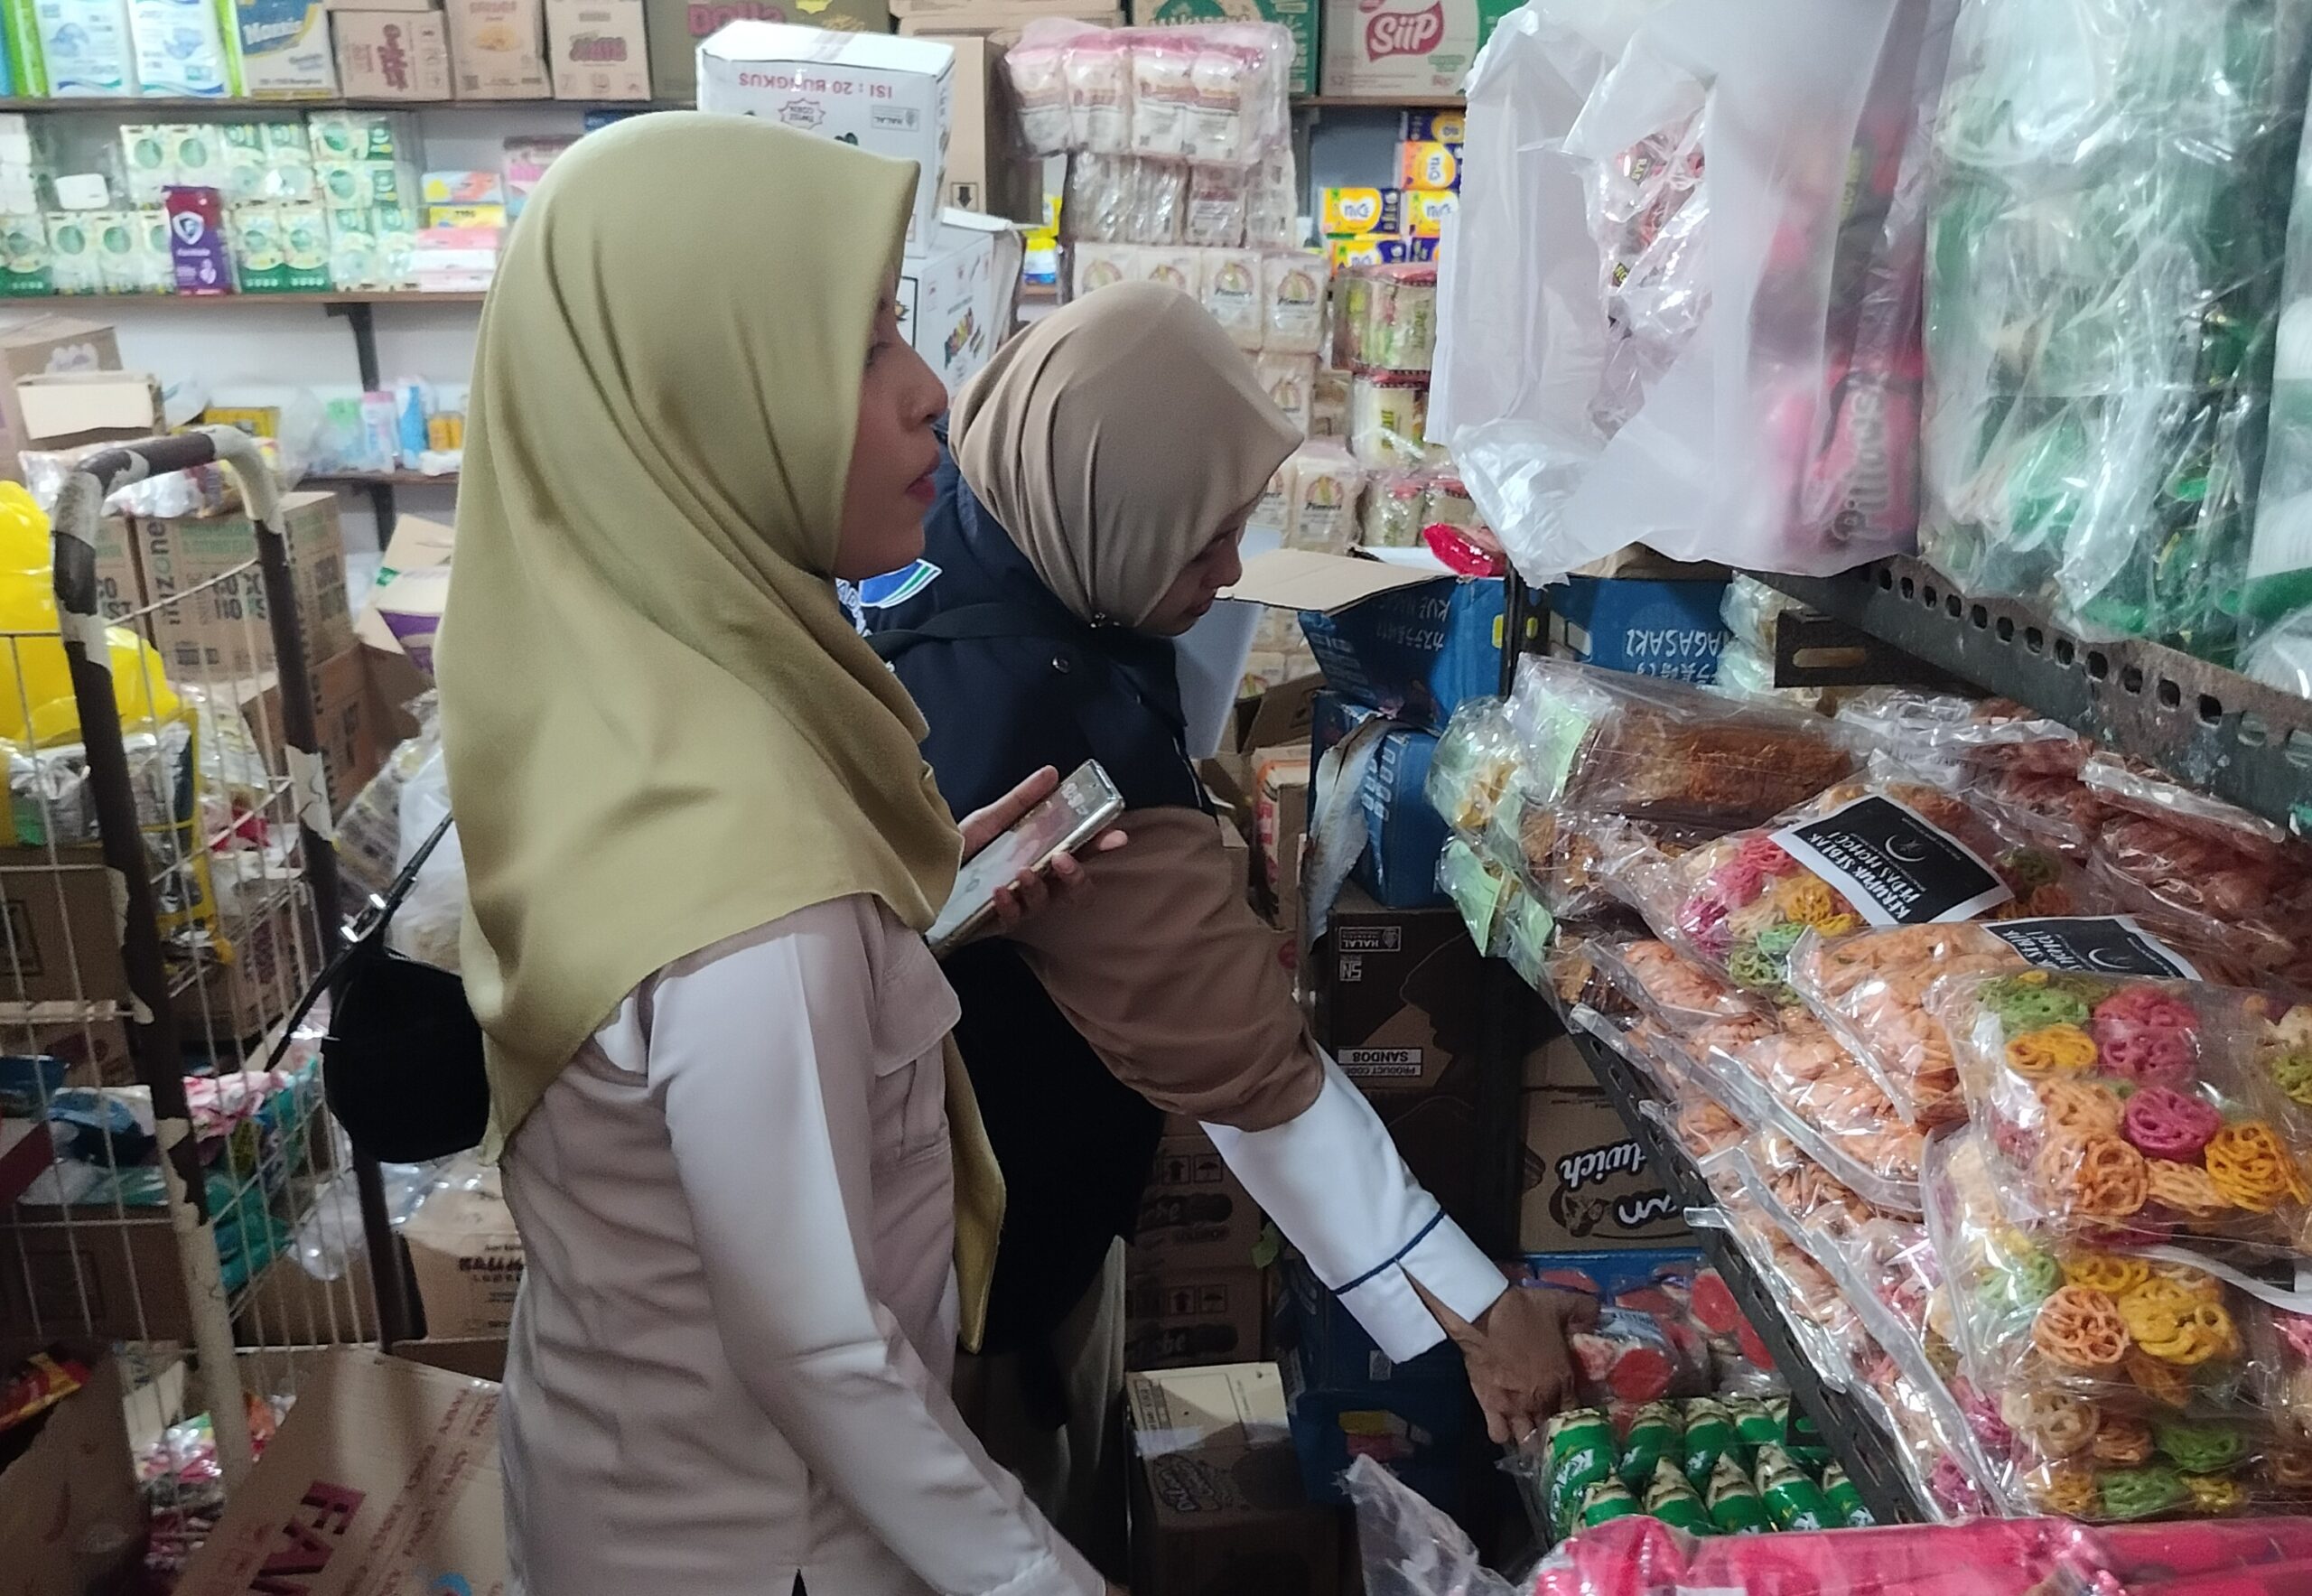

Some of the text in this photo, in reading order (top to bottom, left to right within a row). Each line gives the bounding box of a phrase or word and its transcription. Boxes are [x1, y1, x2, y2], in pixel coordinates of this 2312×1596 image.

[833, 81, 853, 96] 20
[870, 86, 892, 99] ISI
[1852, 863, 1910, 920] KERUPUK
[1878, 866, 1920, 905] PEDAS
